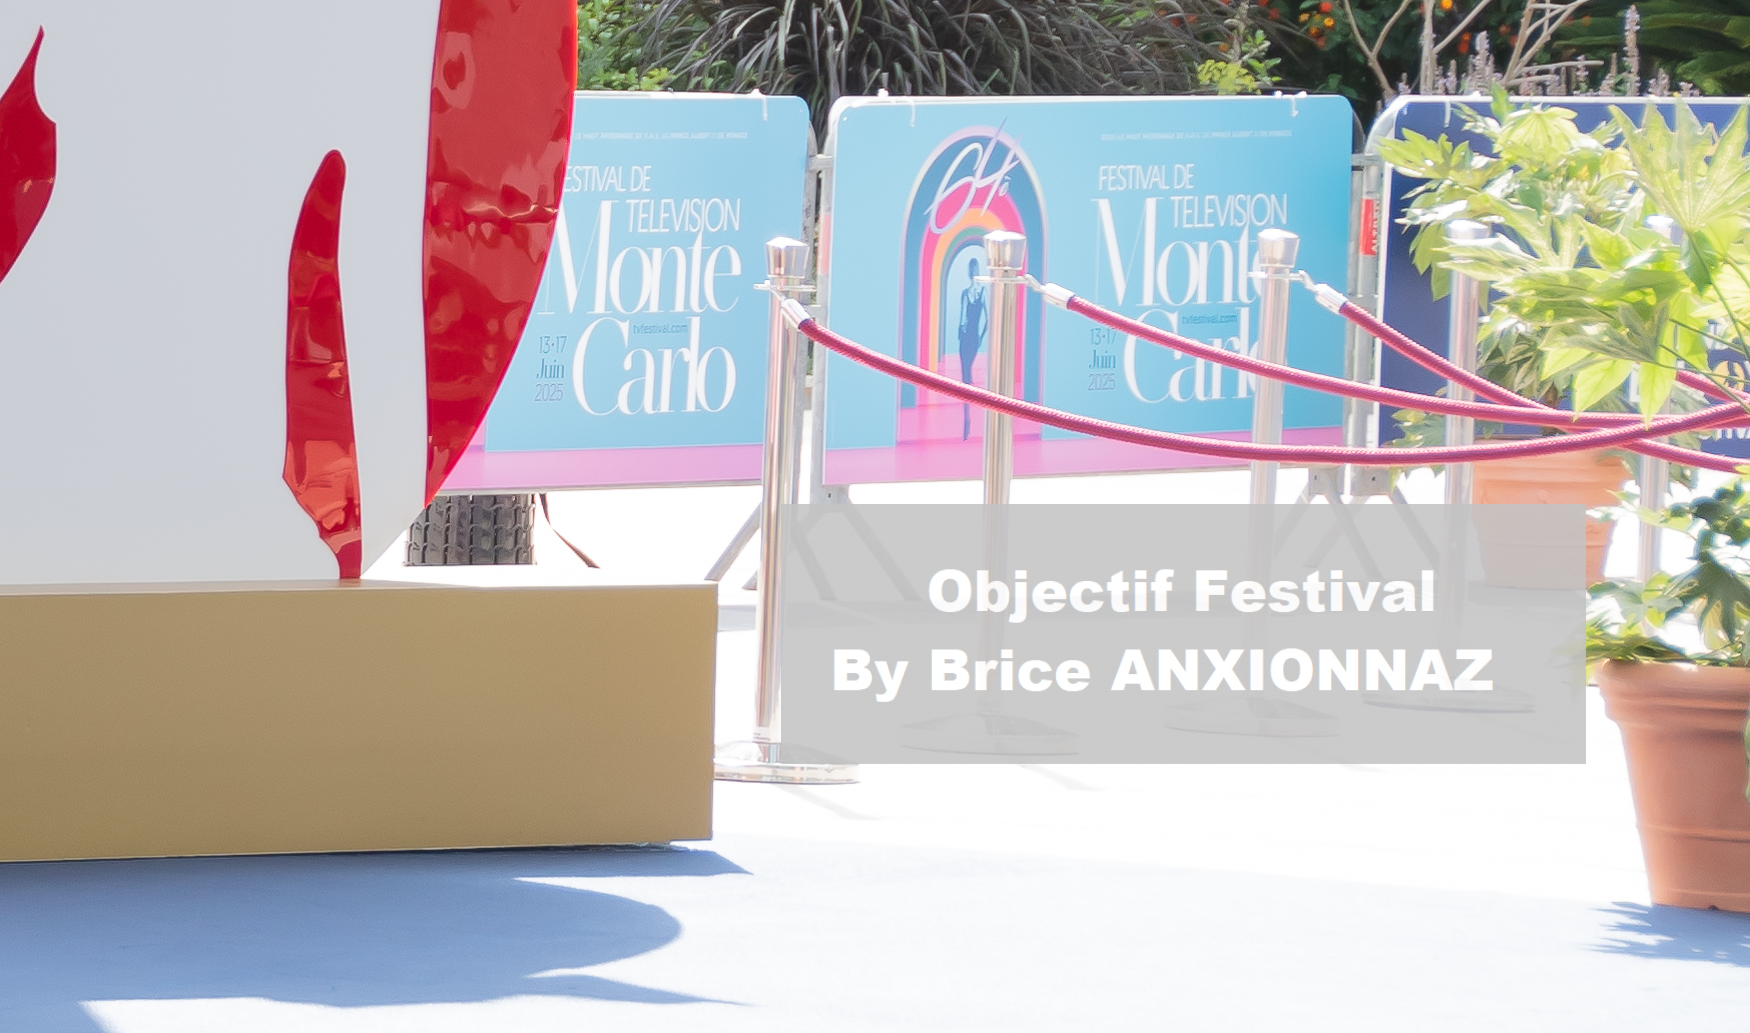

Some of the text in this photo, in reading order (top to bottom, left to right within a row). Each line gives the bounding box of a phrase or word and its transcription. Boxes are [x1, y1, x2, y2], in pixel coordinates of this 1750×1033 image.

[563, 165, 652, 193] ESTIVAL DE
[1098, 163, 1195, 192] FESTIVAL DE
[625, 197, 741, 233] TELEVISION
[1170, 192, 1288, 228] TELEVISION
[536, 199, 742, 315] Monte
[535, 357, 565, 379] Juin
[572, 315, 737, 416] Carlo
[1088, 349, 1117, 369] Juin
[1123, 307, 1260, 404] Carl
[534, 383, 564, 402] 2025
[1087, 372, 1116, 391] 2025
